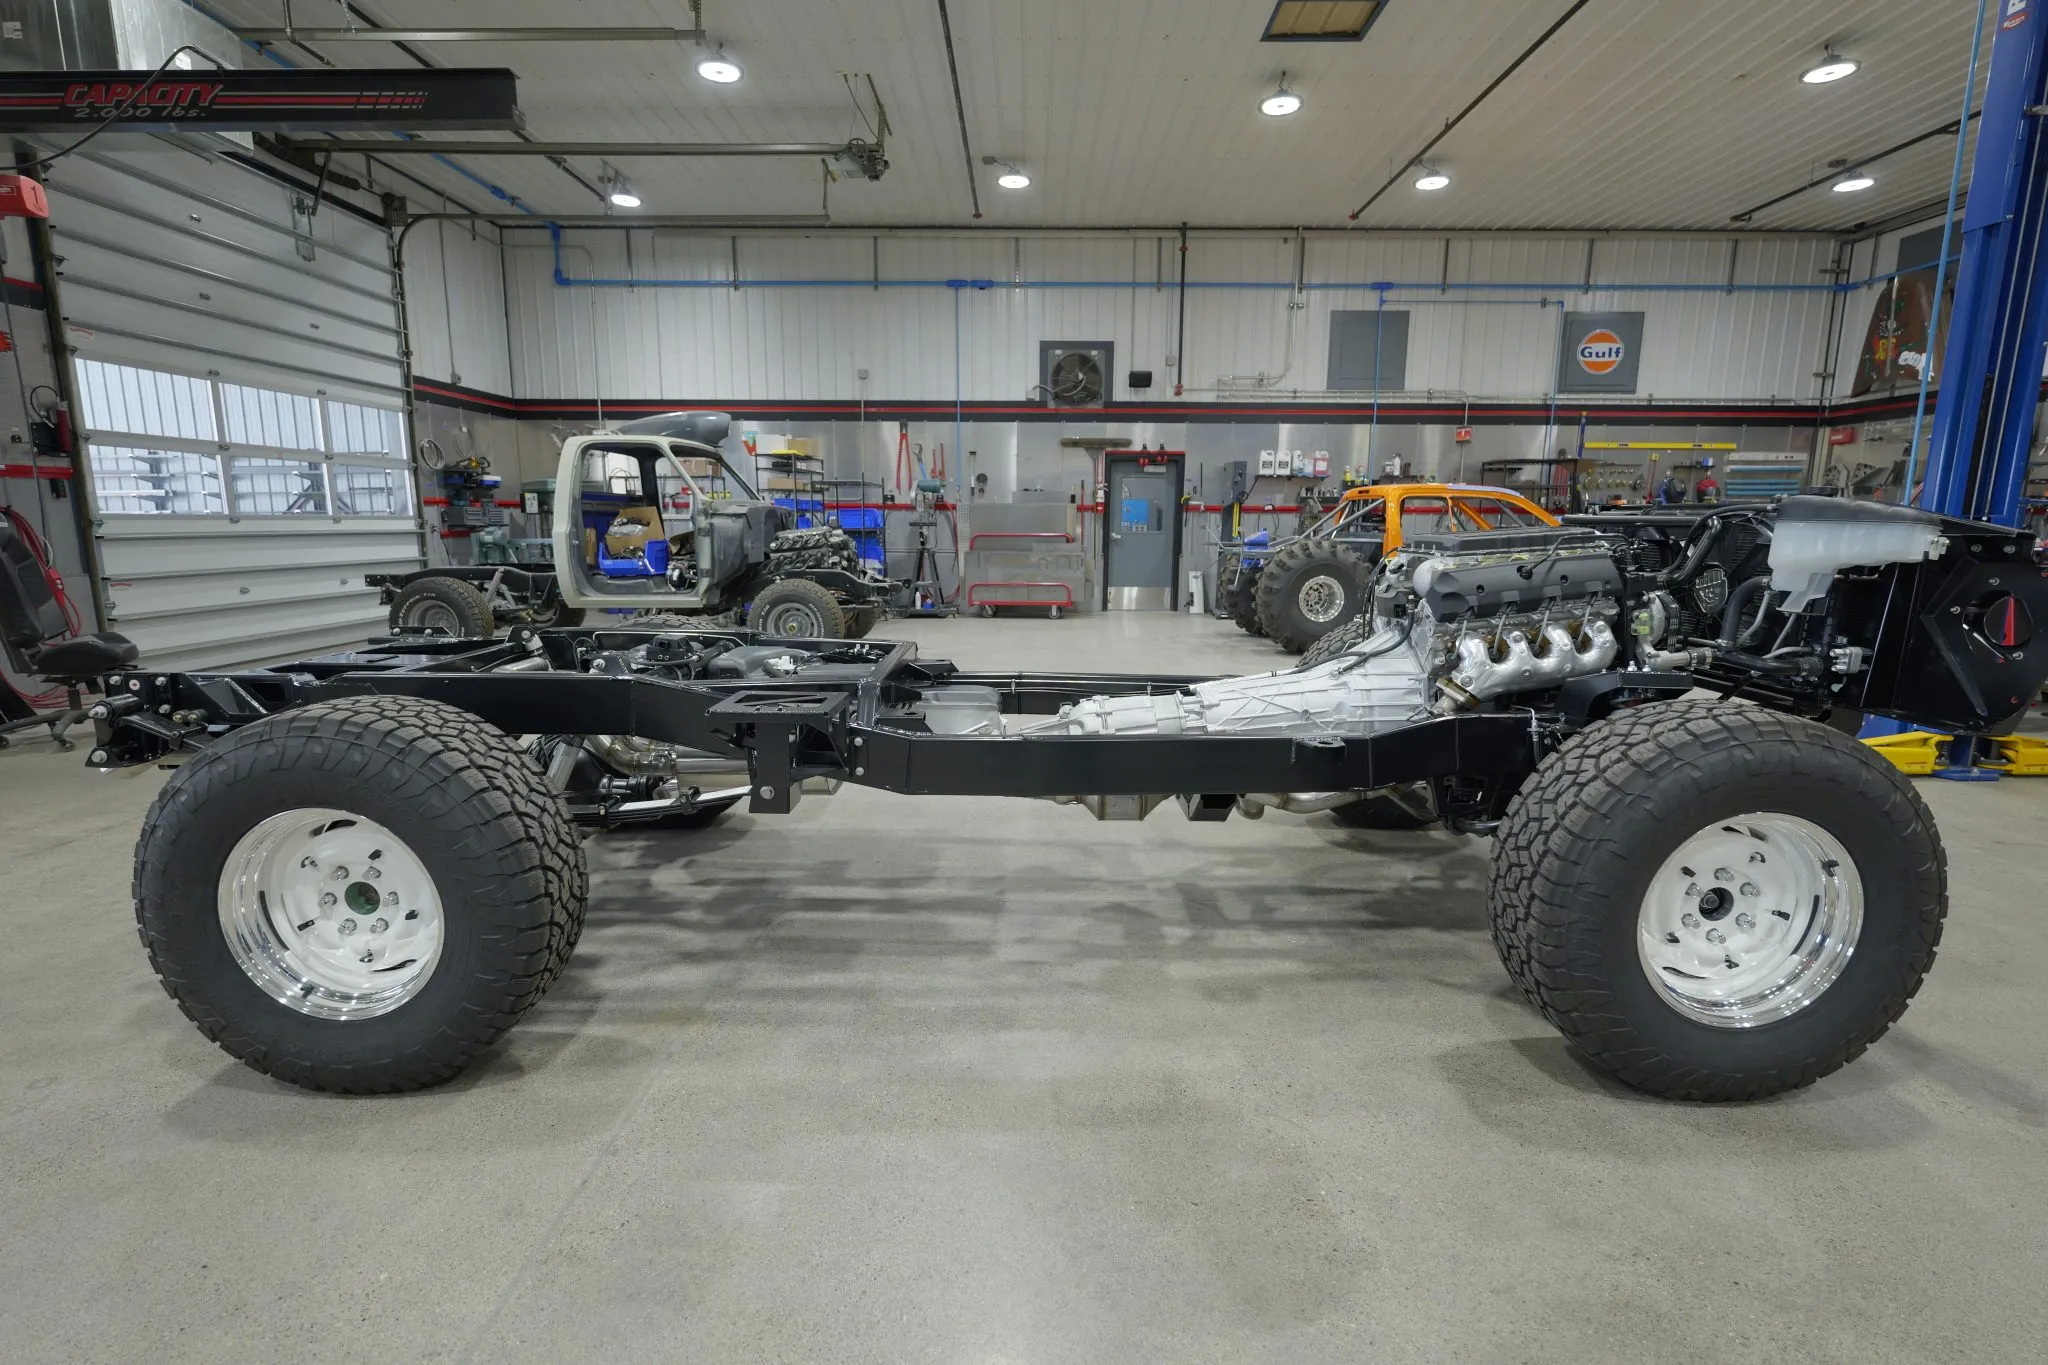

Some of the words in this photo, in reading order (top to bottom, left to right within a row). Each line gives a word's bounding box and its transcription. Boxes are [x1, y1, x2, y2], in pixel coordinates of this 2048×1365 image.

[63, 83, 224, 107] CAPACITY
[160, 106, 207, 118] lbs.
[1580, 346, 1622, 358] Gulf
